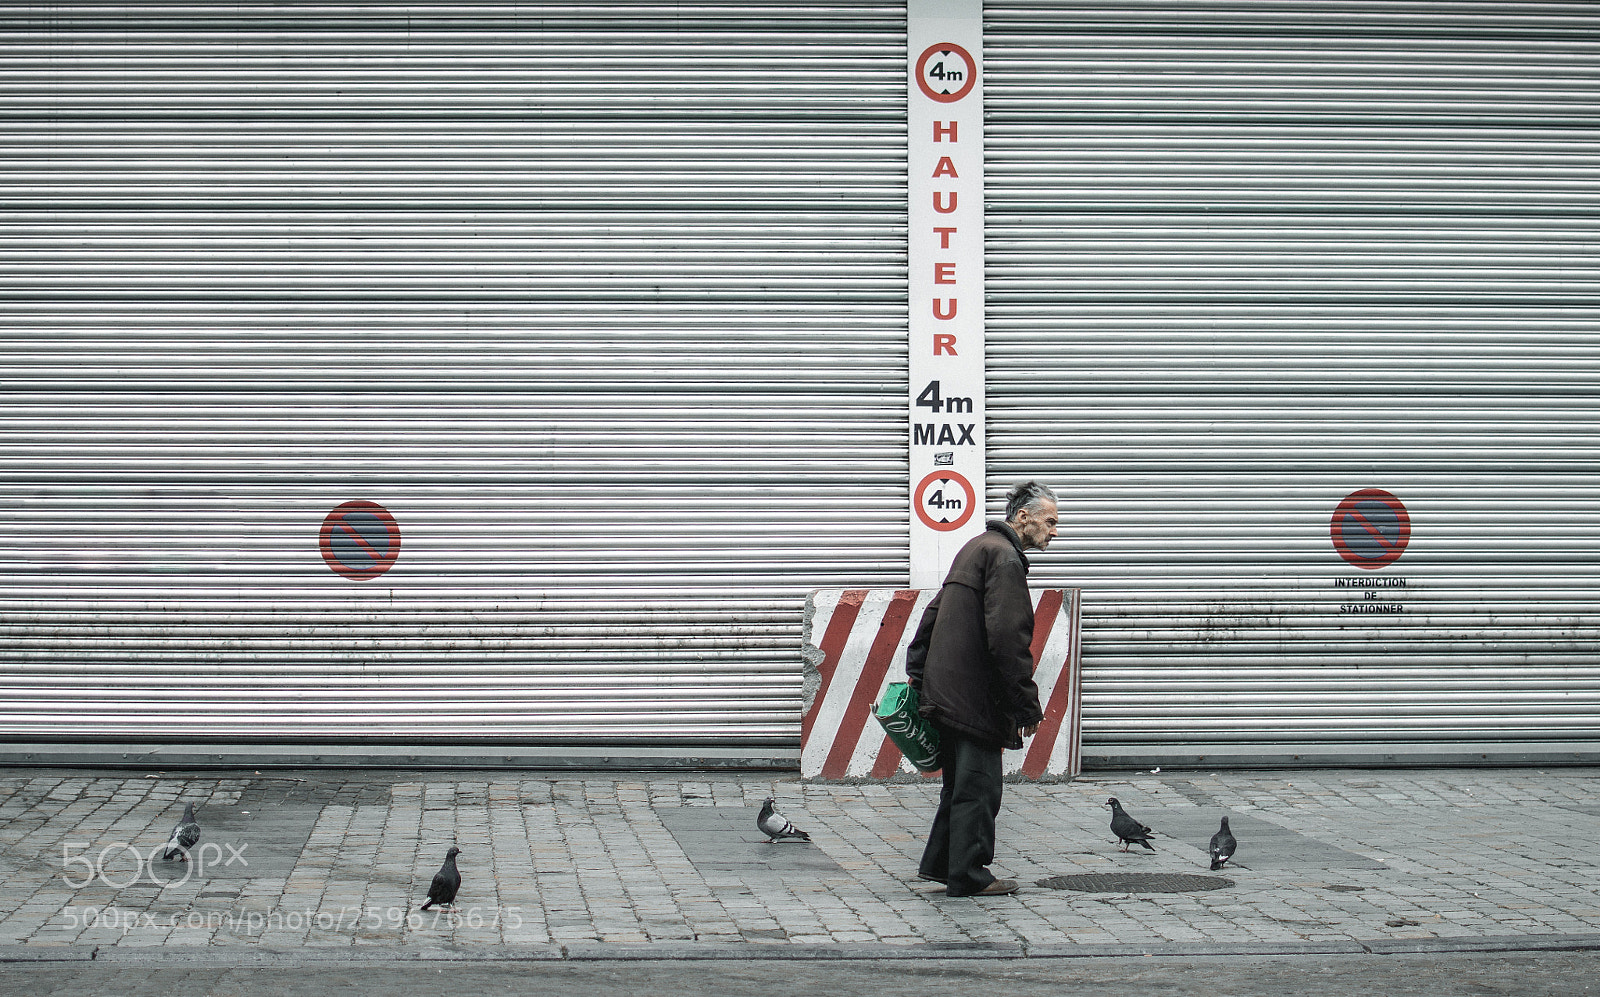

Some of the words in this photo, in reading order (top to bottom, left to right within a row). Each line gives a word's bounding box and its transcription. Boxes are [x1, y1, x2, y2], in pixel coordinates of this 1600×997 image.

[929, 61, 963, 81] 4m
[931, 120, 960, 357] HAUTEUR
[915, 380, 973, 413] 4m
[913, 423, 976, 446] MAX
[928, 489, 962, 510] 4m
[1334, 577, 1407, 588] INTERDICTION
[1364, 591, 1377, 600] DE
[1340, 604, 1404, 614] STATIONNER
